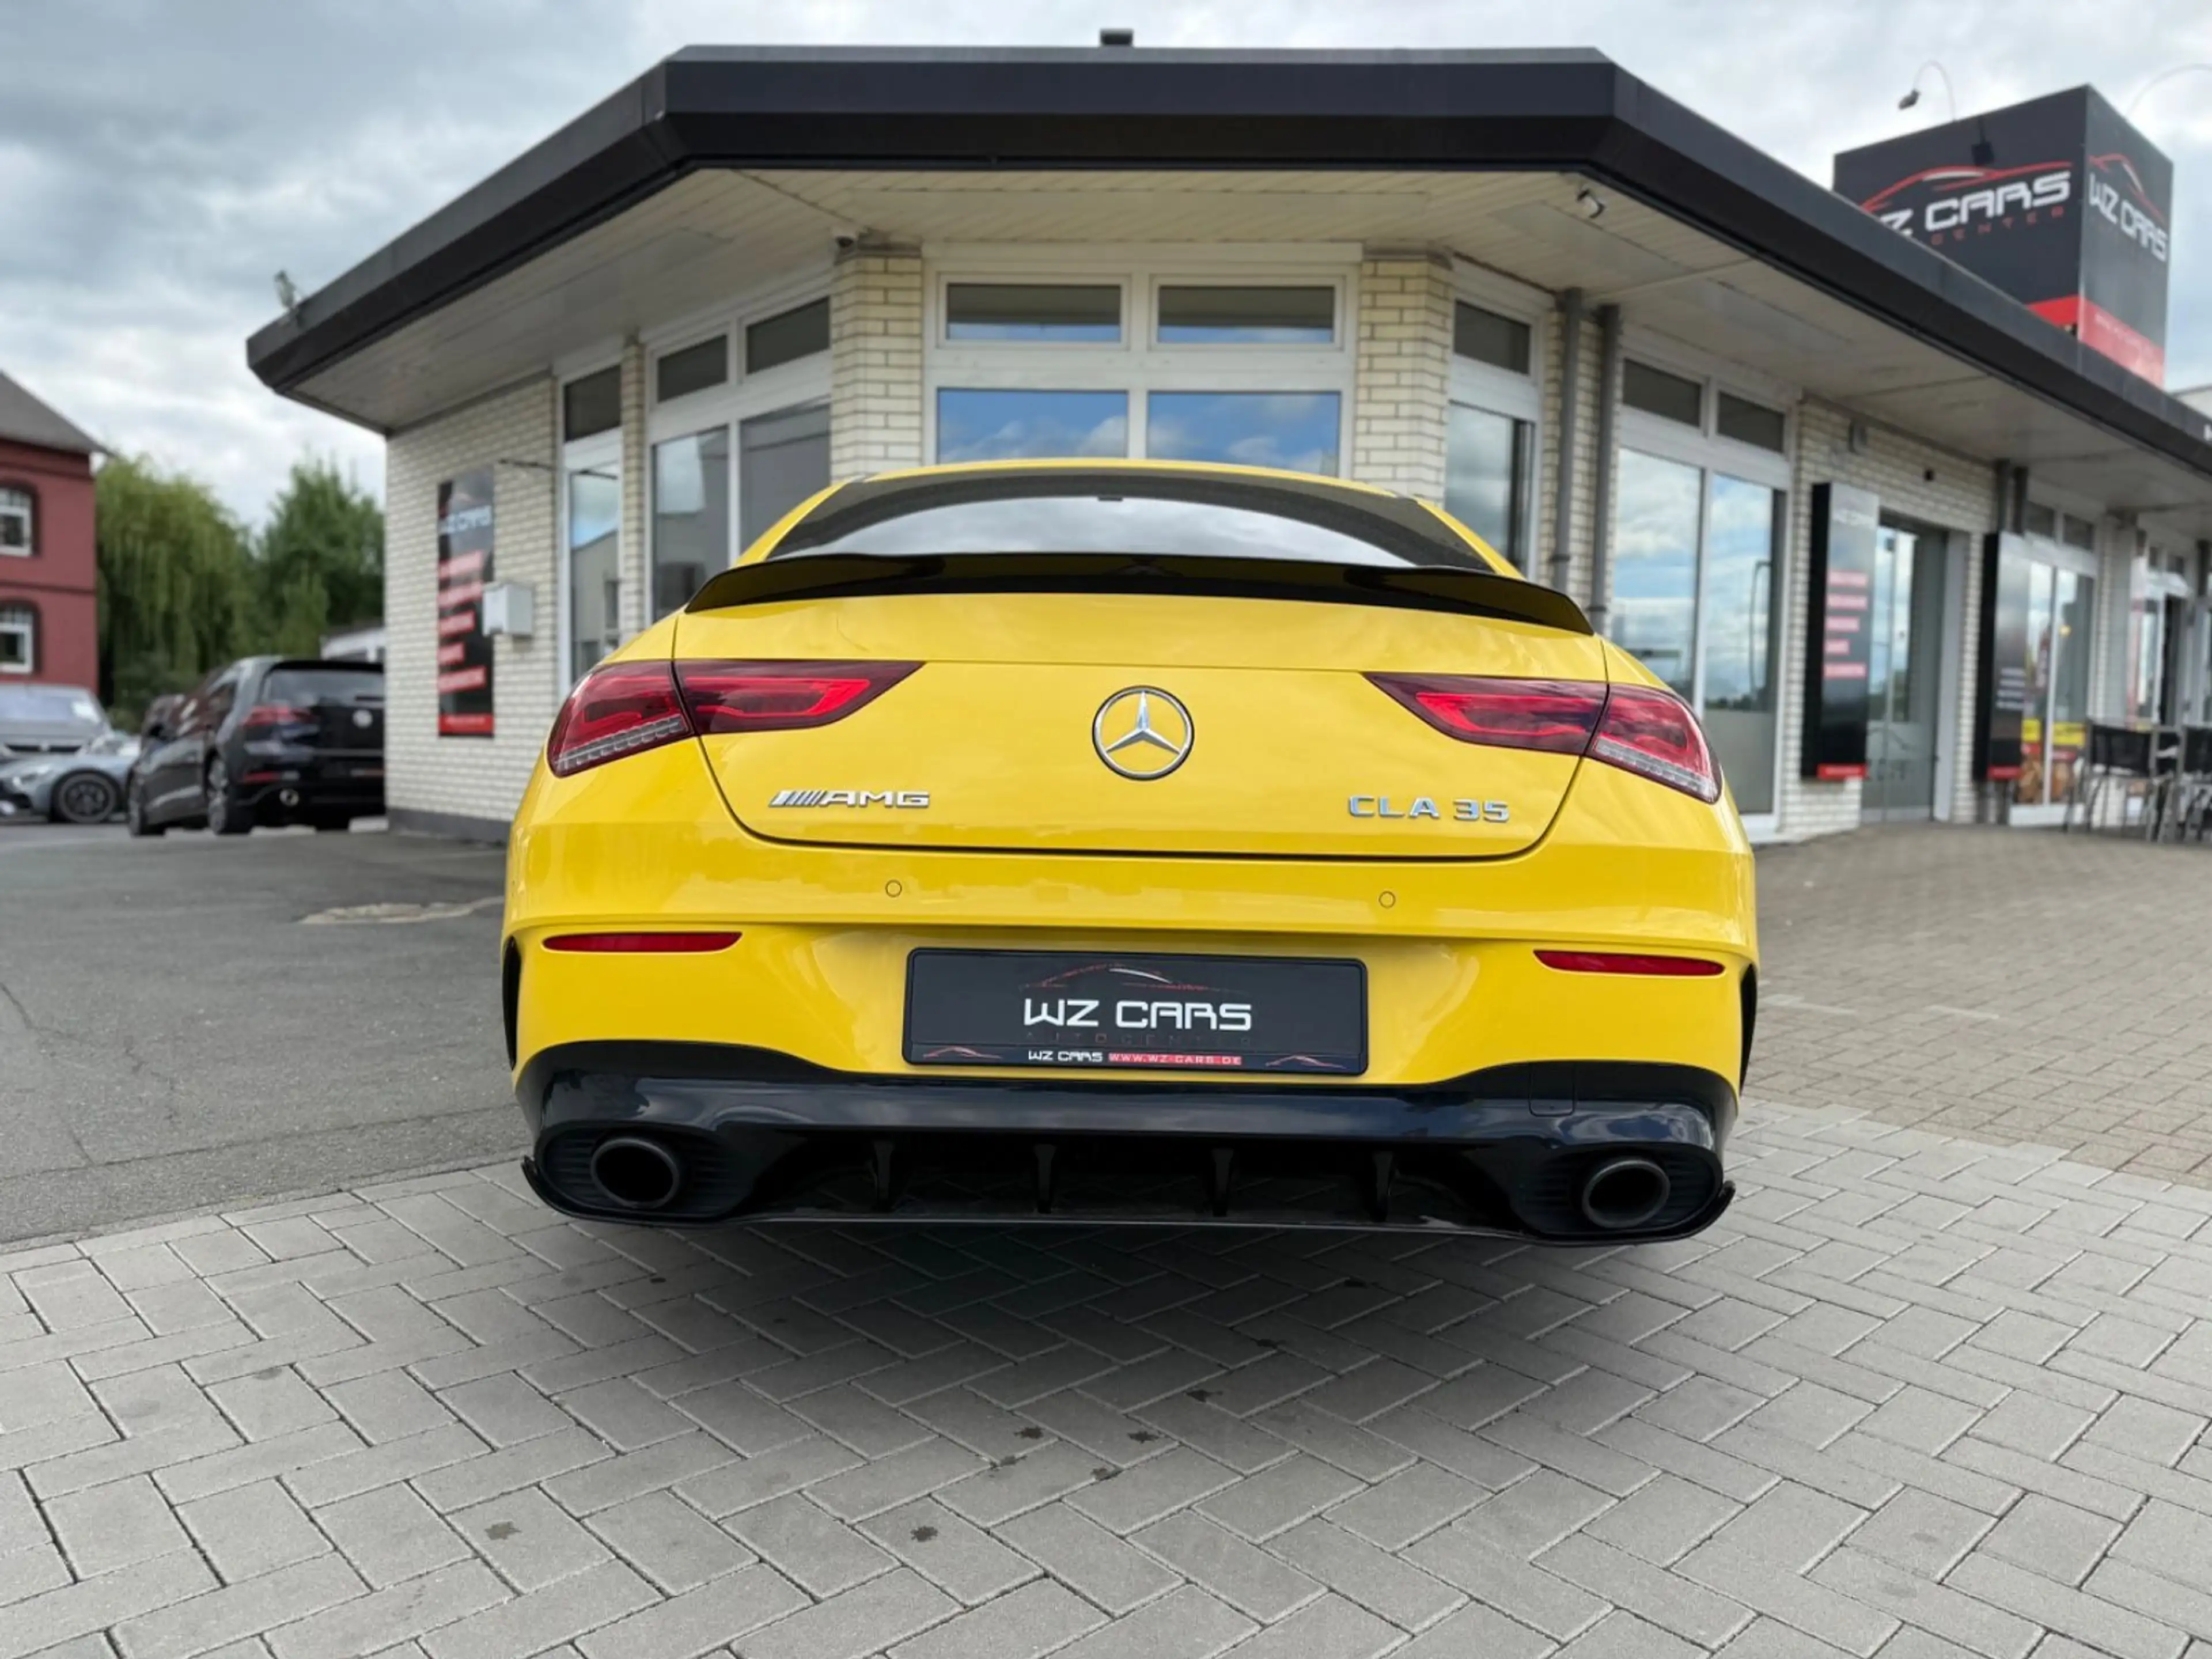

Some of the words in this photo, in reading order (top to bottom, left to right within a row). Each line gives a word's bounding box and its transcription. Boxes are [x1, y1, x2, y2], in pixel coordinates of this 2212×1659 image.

[1925, 171, 2071, 232] CARS
[2120, 199, 2169, 263] CARS
[816, 789, 930, 808] AMG
[1349, 795, 1440, 819] CLA
[1453, 798, 1510, 823] 35
[1024, 998, 1099, 1027] WZ
[1115, 1001, 1252, 1031] CARS
[1028, 1050, 1053, 1062] WZ
[1058, 1051, 1103, 1063] CARS
